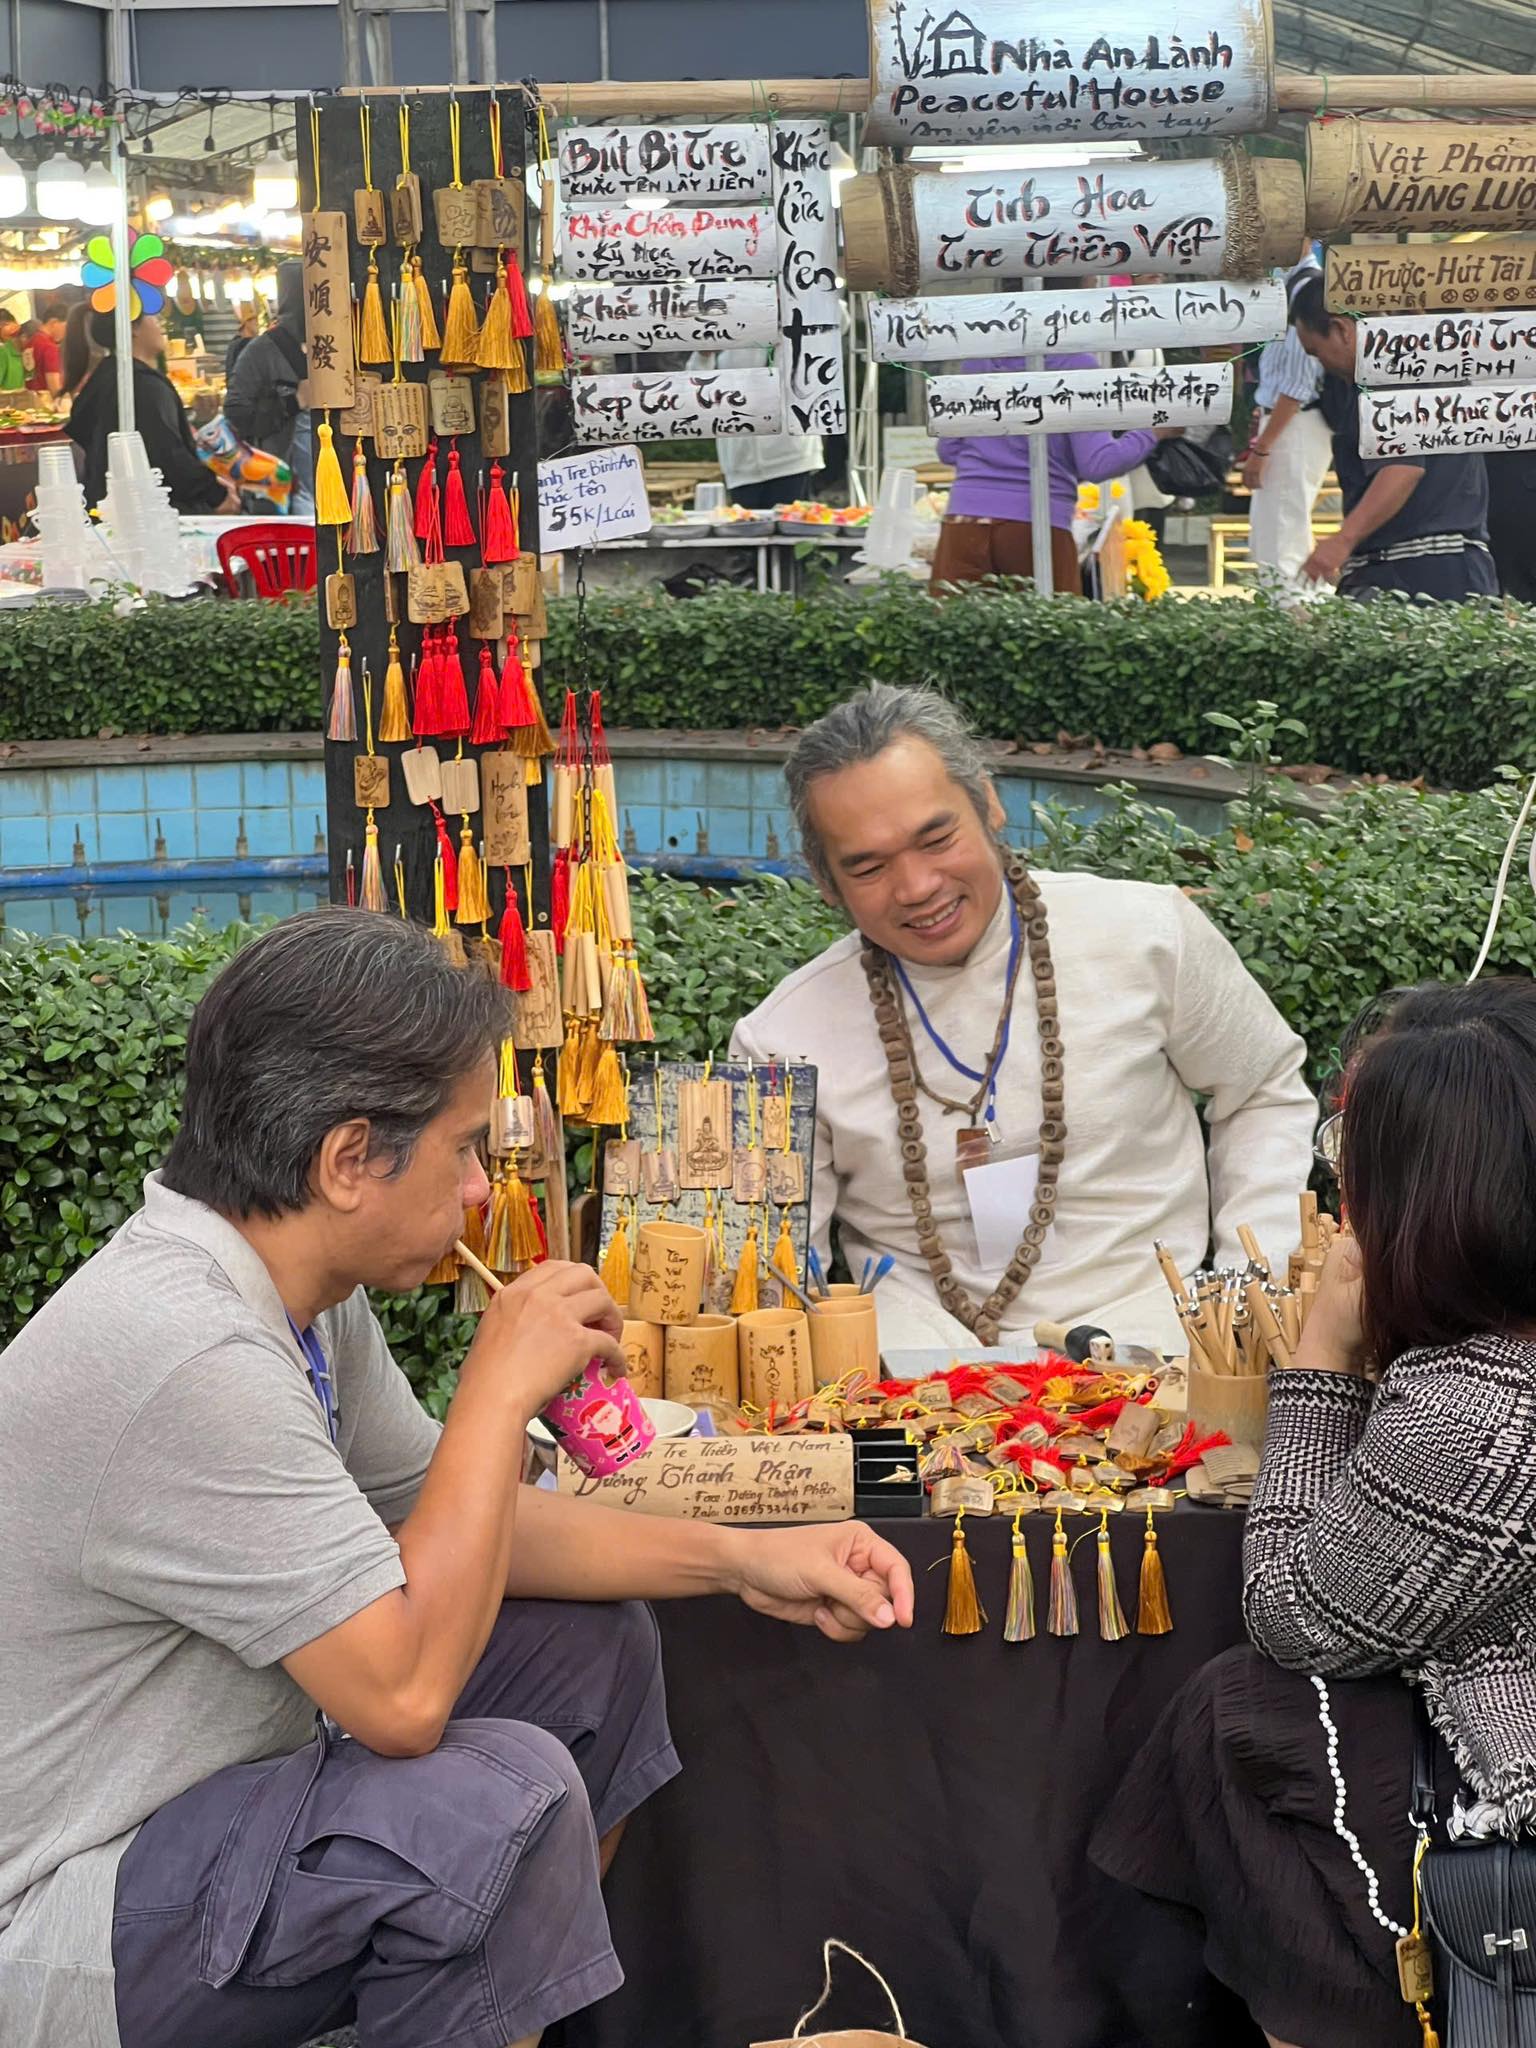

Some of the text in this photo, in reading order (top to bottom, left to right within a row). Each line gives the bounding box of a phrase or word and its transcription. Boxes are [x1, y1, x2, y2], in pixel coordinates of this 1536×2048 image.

[992, 31, 1233, 75] Nhà An Lành
[891, 75, 1226, 117] Peaceful House
[639, 130, 679, 174] Bi
[683, 127, 748, 171] Tre
[966, 174, 1158, 228] Tinh Hoa
[1358, 176, 1536, 216] NĂNG LƯỢ
[937, 230, 1007, 272] Tre
[1133, 213, 1222, 265] Việt
[689, 375, 748, 410] Tre
[1492, 387, 1536, 423] Trâ
[562, 464, 590, 481] Tre
[662, 1442, 689, 1459] Tre
[788, 1439, 832, 1453] Nam
